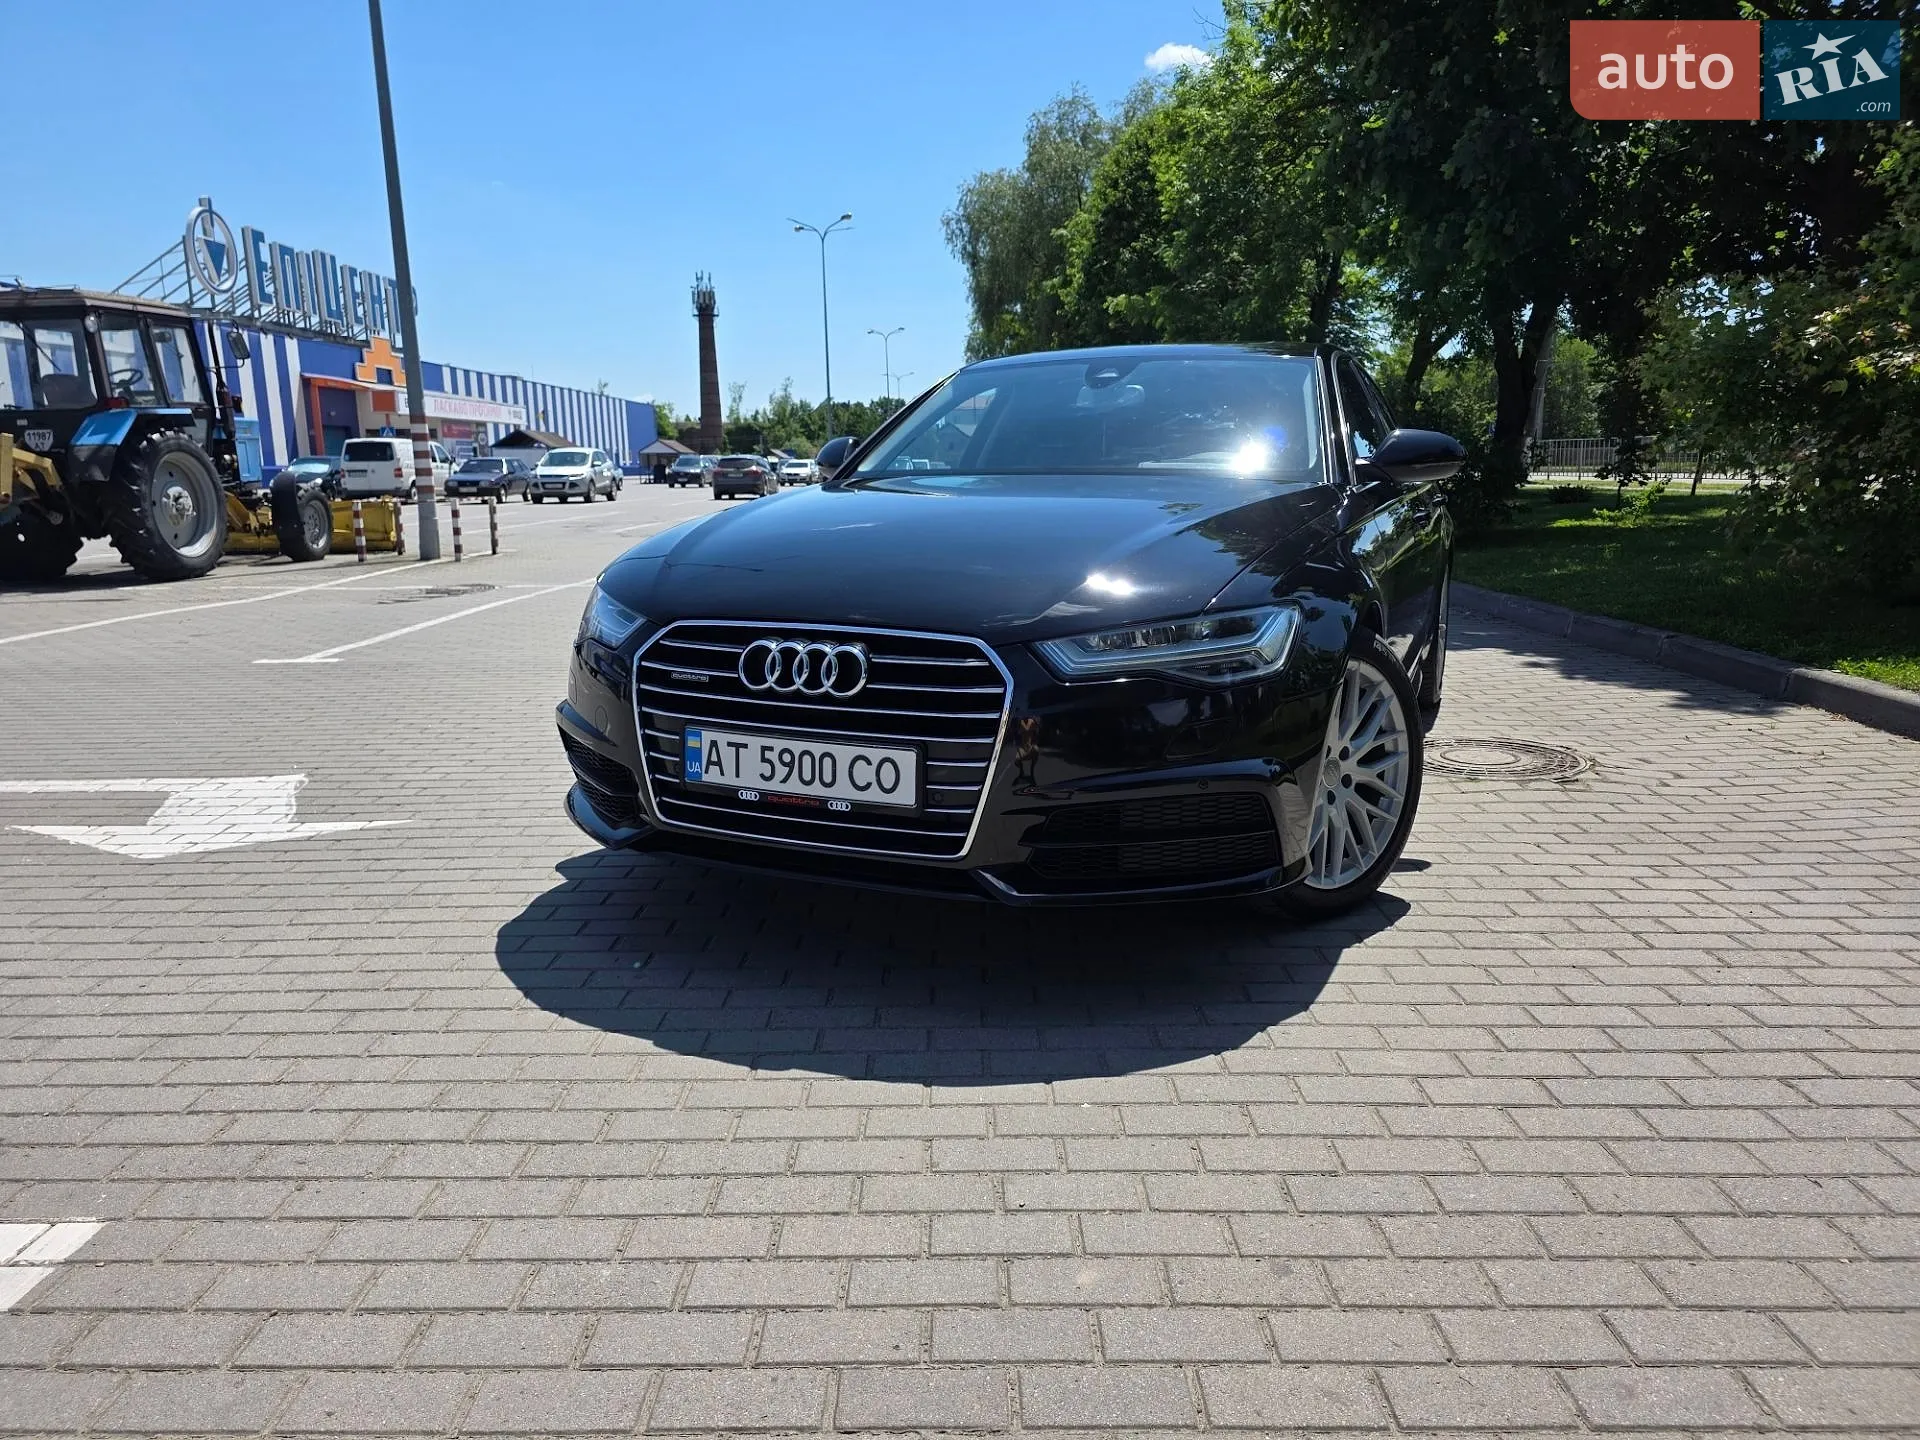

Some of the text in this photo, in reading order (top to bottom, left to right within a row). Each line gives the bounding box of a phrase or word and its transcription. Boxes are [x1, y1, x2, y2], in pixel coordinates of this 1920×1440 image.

[242, 225, 418, 335] ЕПІЦЕНТ
[687, 760, 702, 774] UA
[704, 739, 901, 795] AT 5900 CO
[767, 794, 820, 806] quattro
